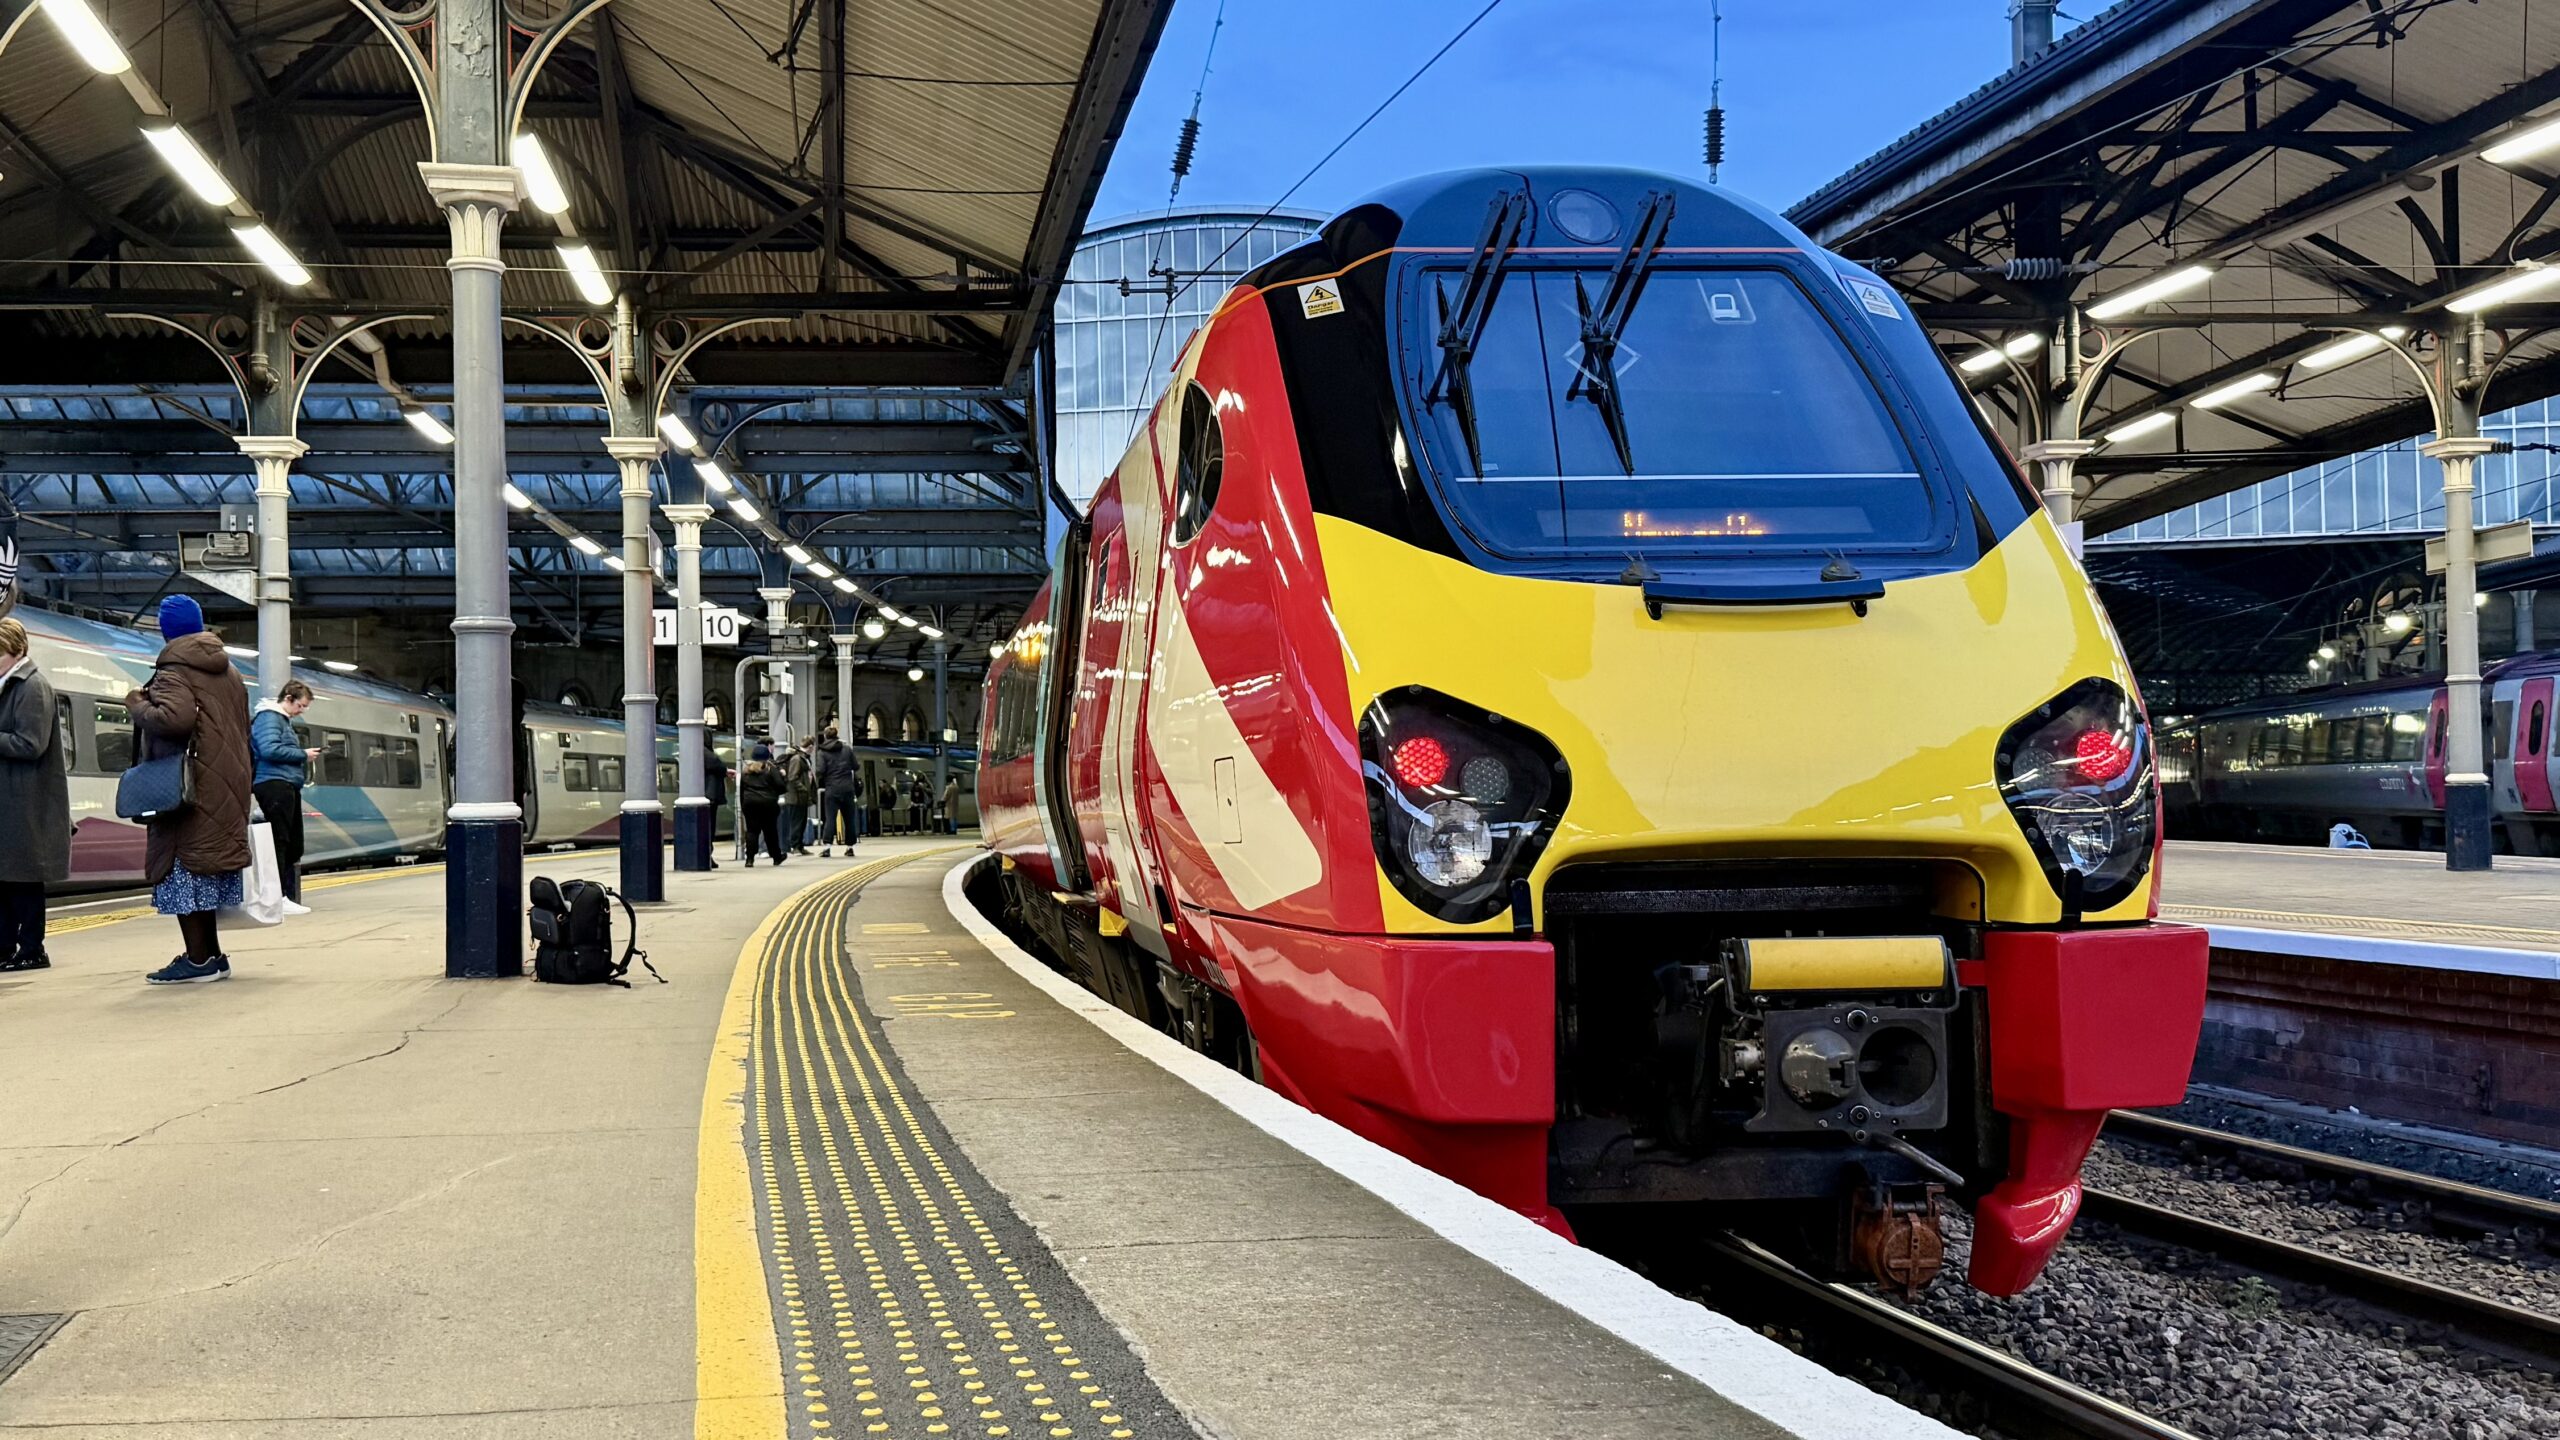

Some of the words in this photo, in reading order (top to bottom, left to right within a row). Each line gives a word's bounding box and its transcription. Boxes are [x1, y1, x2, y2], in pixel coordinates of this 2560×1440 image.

[706, 615, 734, 638] 10
[868, 950, 960, 968] THE
[887, 992, 1017, 1019] GAP
